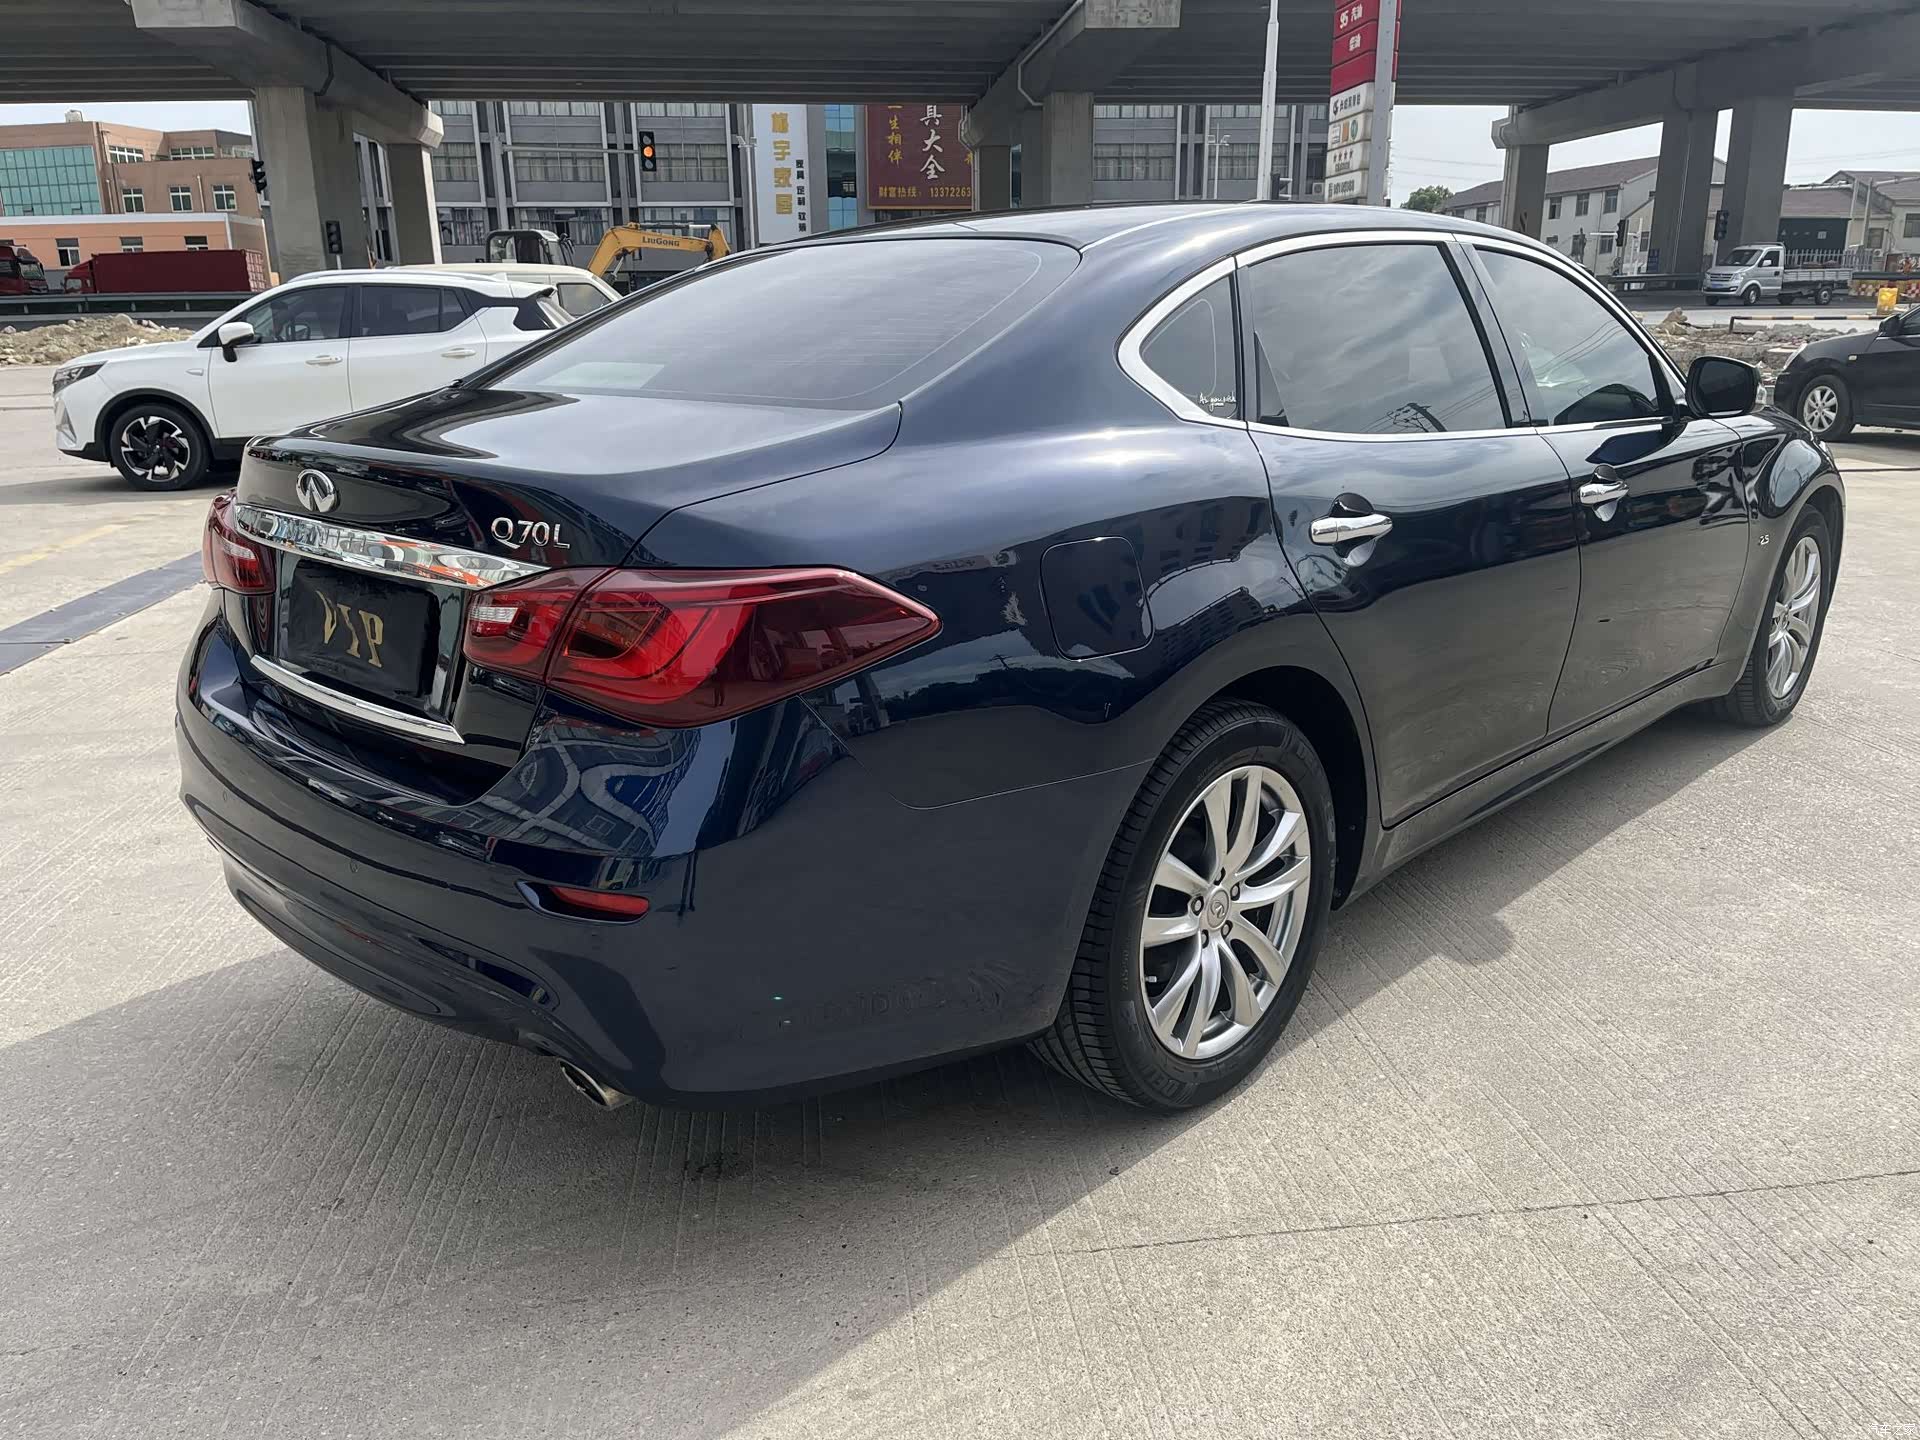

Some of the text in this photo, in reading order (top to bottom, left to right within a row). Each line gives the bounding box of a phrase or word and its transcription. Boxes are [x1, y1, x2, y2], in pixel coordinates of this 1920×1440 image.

[887, 105, 903, 168] 一生相伴
[490, 516, 571, 550] Q70L
[315, 588, 385, 669] VIP
